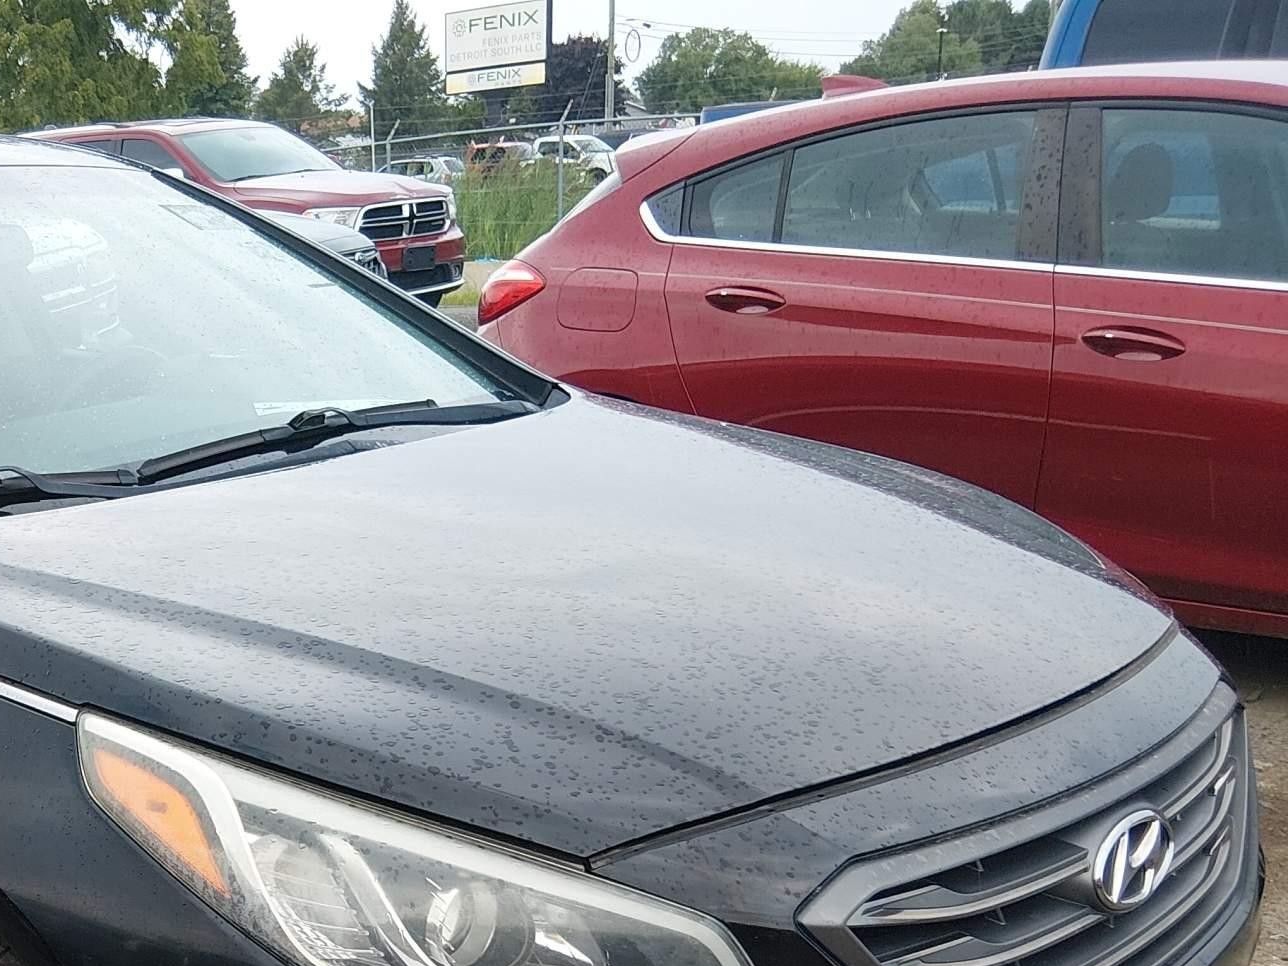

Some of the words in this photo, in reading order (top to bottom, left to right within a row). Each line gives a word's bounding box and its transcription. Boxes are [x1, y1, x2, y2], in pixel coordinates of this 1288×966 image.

[469, 9, 539, 33] FENIX
[482, 36, 509, 47] FENIX
[512, 32, 542, 43] PARTS
[450, 49, 488, 63] DETROIT
[491, 46, 522, 57] SOUTH
[525, 42, 542, 53] LLC
[477, 68, 521, 83] FENIX
